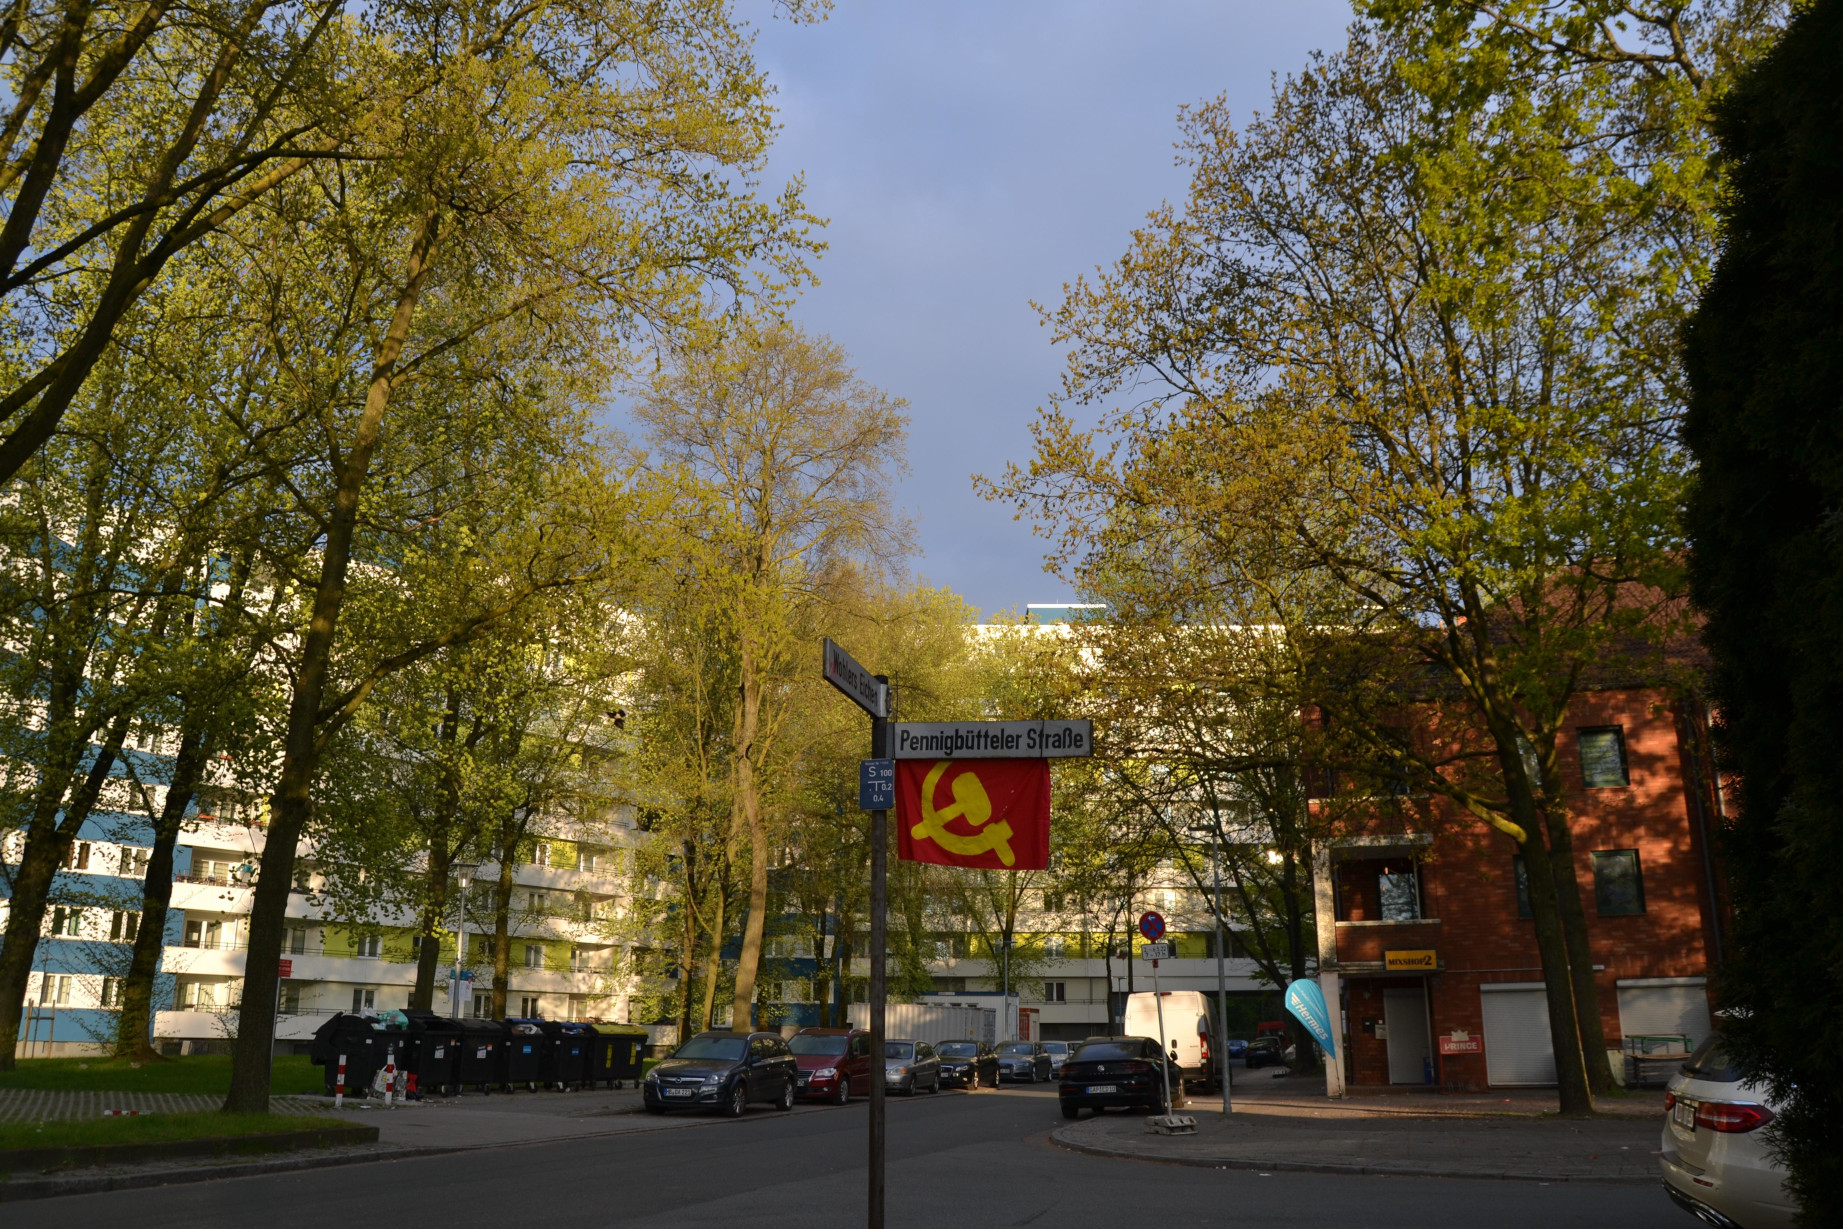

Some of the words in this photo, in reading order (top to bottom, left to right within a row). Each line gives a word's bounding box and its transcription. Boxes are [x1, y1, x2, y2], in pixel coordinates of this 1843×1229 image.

[833, 649, 858, 690] Wohlers
[859, 672, 878, 707] Eichen
[900, 728, 1022, 756] Pennigbütteler
[1027, 727, 1084, 750] Straße
[868, 766, 877, 777] S
[880, 769, 893, 777] 100
[1295, 1003, 1328, 1040] Hermes
[1444, 1042, 1478, 1050] PRINCE
